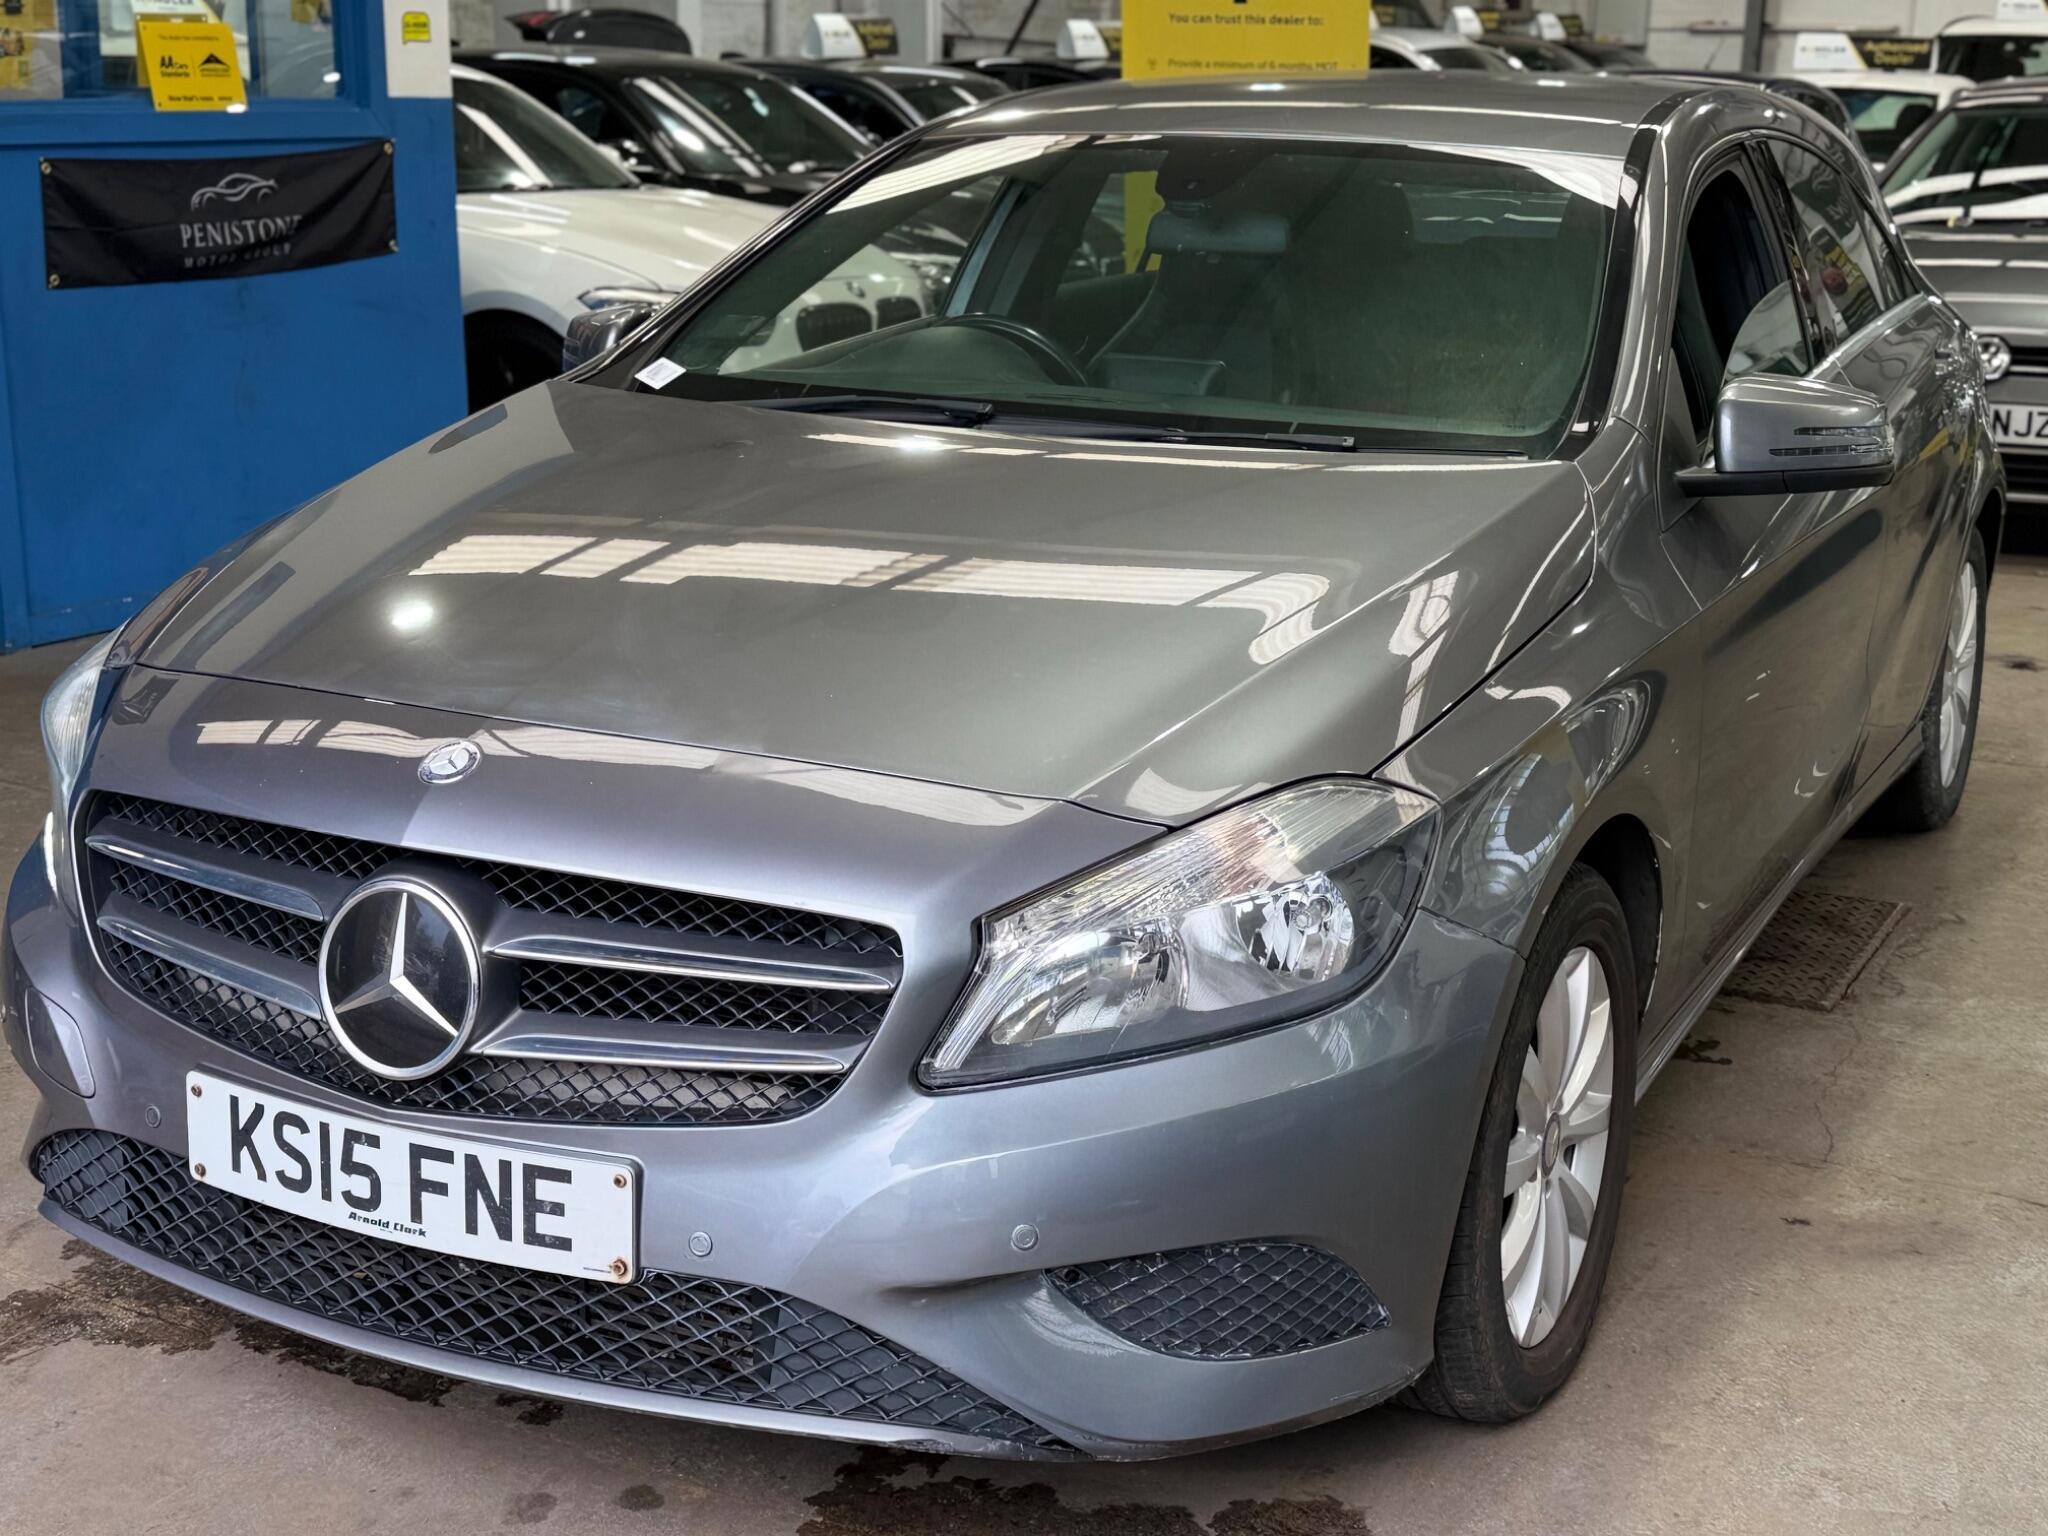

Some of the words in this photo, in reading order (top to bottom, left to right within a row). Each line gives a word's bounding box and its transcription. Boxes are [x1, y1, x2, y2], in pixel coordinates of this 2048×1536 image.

[1168, 12, 1189, 25] You
[1191, 14, 1213, 25] can
[1215, 13, 1242, 25] trust
[1244, 13, 1265, 26] this
[1269, 13, 1305, 26] dealer
[1308, 14, 1325, 27] to:
[1168, 58, 1202, 69] Provide
[1213, 60, 1255, 70] minimum
[1257, 59, 1268, 70] of
[1992, 409, 2048, 438] NJZ
[230, 1094, 382, 1213] KS15
[409, 1142, 573, 1252] FNE
[348, 1211, 390, 1229] Arnold
[393, 1222, 427, 1238] Clark
